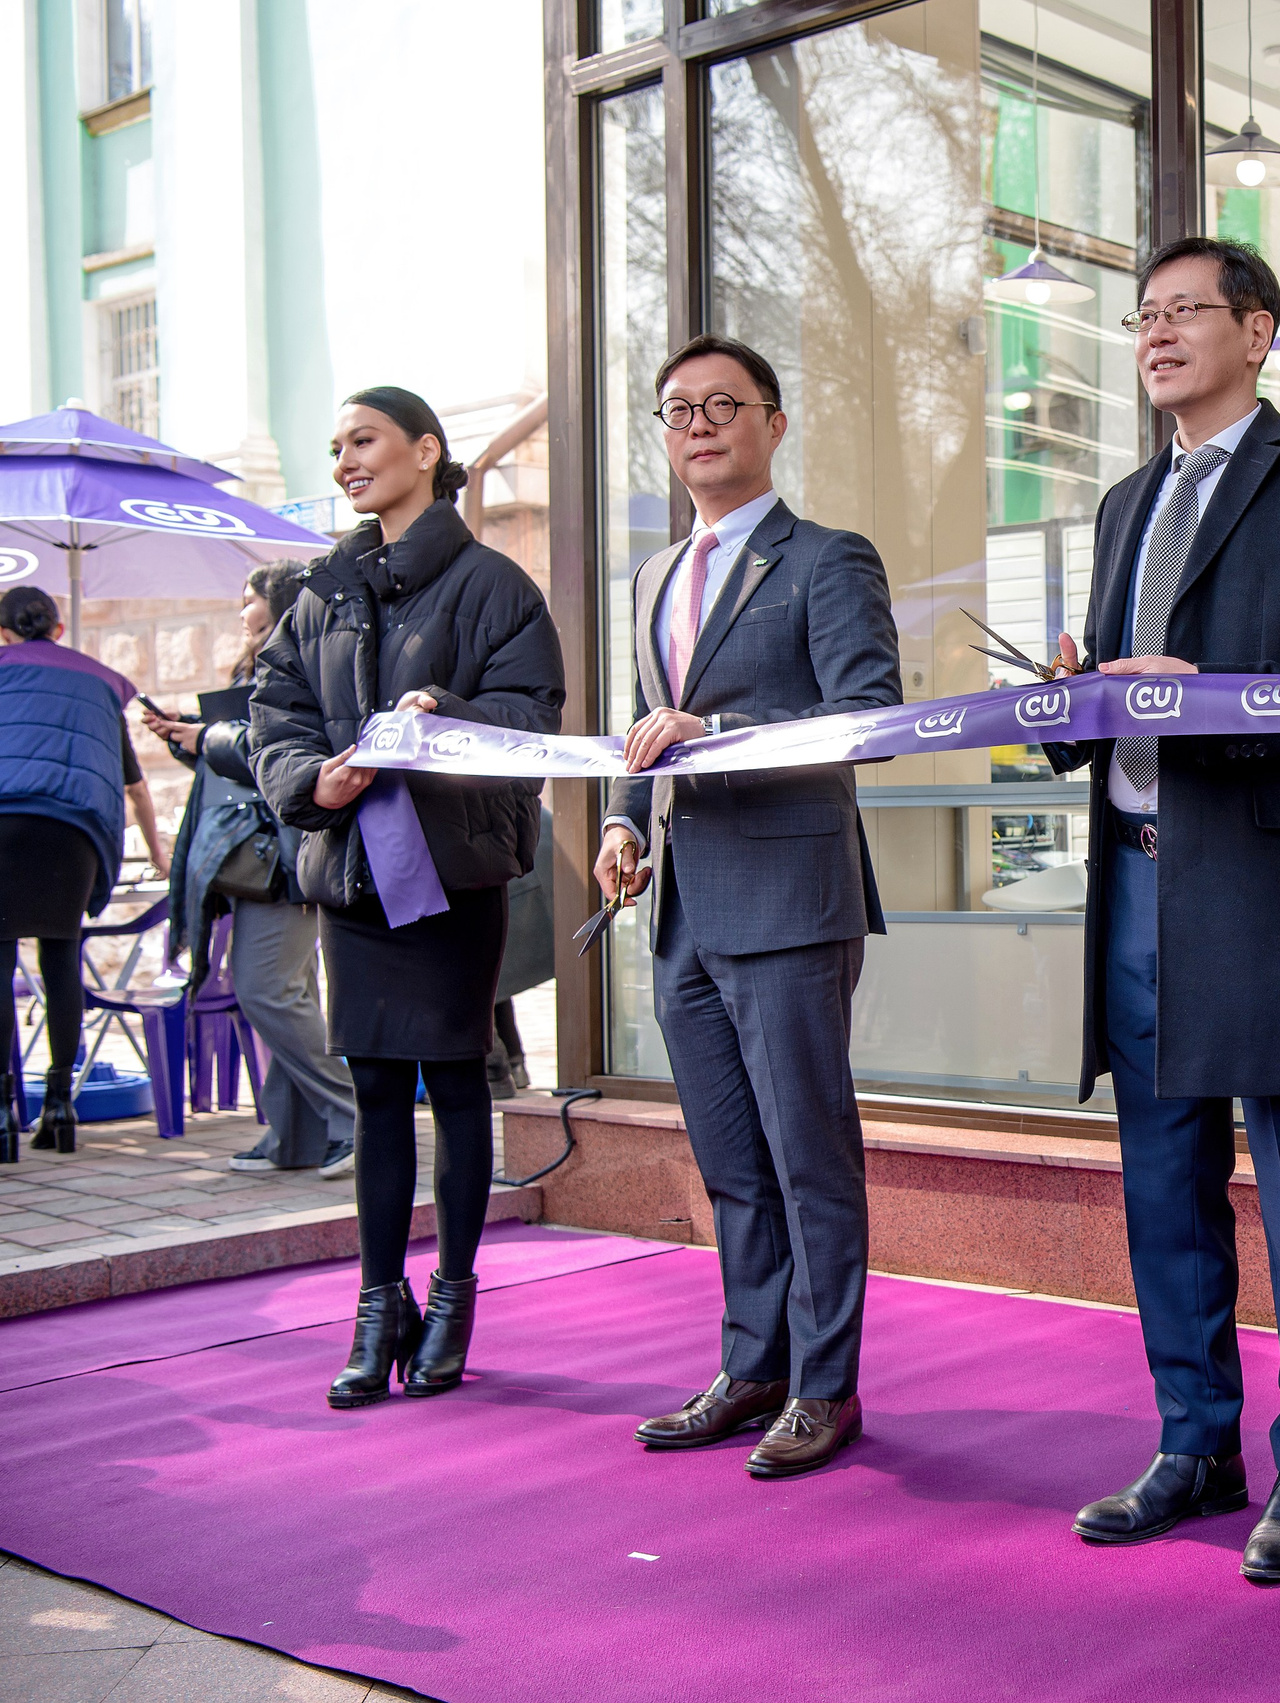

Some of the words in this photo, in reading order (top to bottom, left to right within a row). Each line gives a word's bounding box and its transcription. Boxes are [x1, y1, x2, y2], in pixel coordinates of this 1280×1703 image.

[144, 505, 221, 527] CU
[1025, 693, 1060, 717] CU
[1136, 686, 1172, 709] CU
[924, 710, 957, 728] CU
